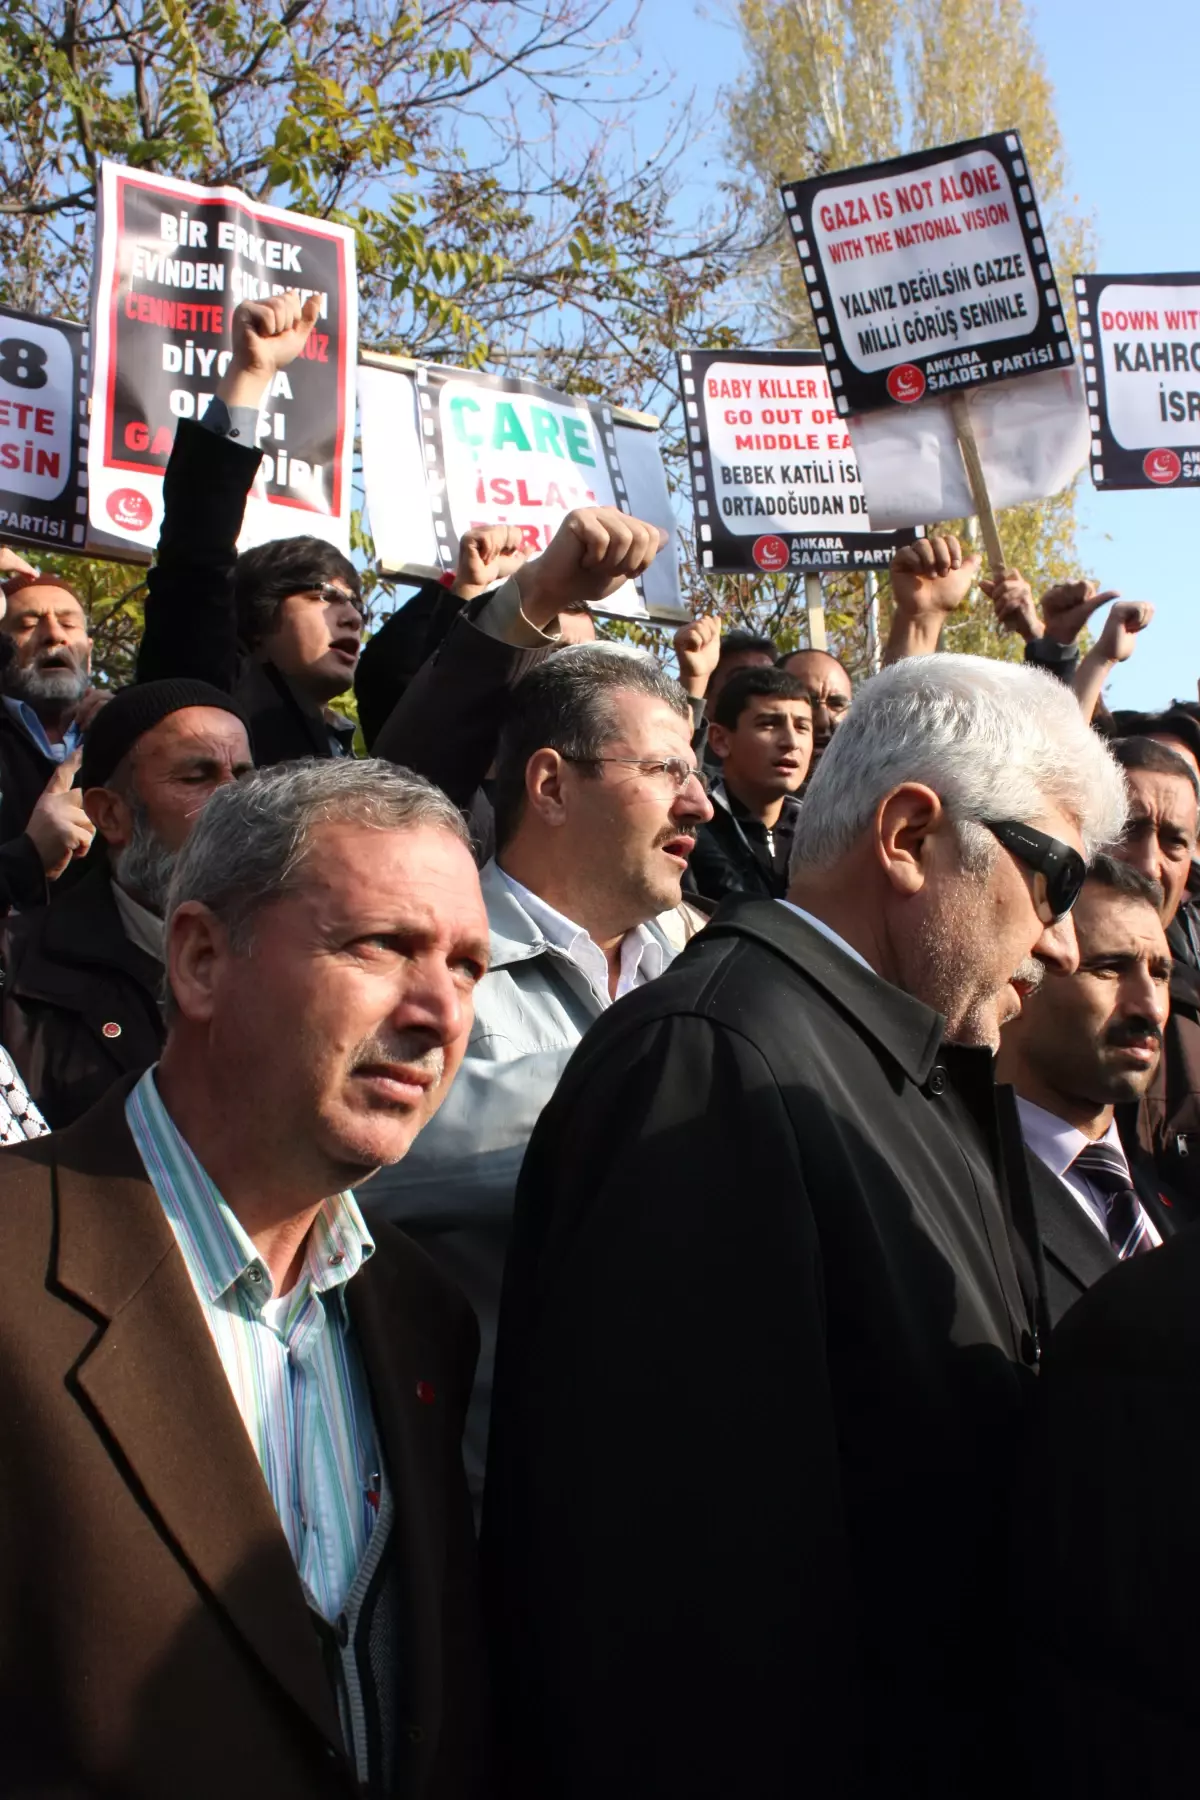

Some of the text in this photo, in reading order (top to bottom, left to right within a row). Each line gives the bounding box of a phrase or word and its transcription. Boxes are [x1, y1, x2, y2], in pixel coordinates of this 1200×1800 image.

[820, 164, 1000, 232] GAZA IS NOT ALONE
[160, 211, 302, 273] BİR ERKEK
[828, 203, 1010, 264] WITH THE NATIONAL VISION
[840, 254, 1025, 320] YALNIZ DEĞİLSİN GAZZE
[125, 292, 224, 334] CENNETTE
[858, 293, 1027, 356] MİLLİ GÖRÜŞ SENİNLE
[1101, 310, 1200, 331] DOWN WIT
[926, 351, 980, 375] ANKARA
[927, 344, 1054, 390] SAADET PARTİSİ
[708, 379, 752, 398] BABY
[759, 380, 817, 398] KILLER
[724, 409, 752, 425] GO
[762, 409, 802, 425] OUT
[735, 434, 819, 450] MIDDLE
[721, 465, 776, 484] BEBEK
[781, 460, 834, 483] KATİLİ
[723, 491, 844, 517] ORTADOĞUDAN
[791, 537, 843, 550] ANKARA
[791, 551, 849, 565] SAADET
